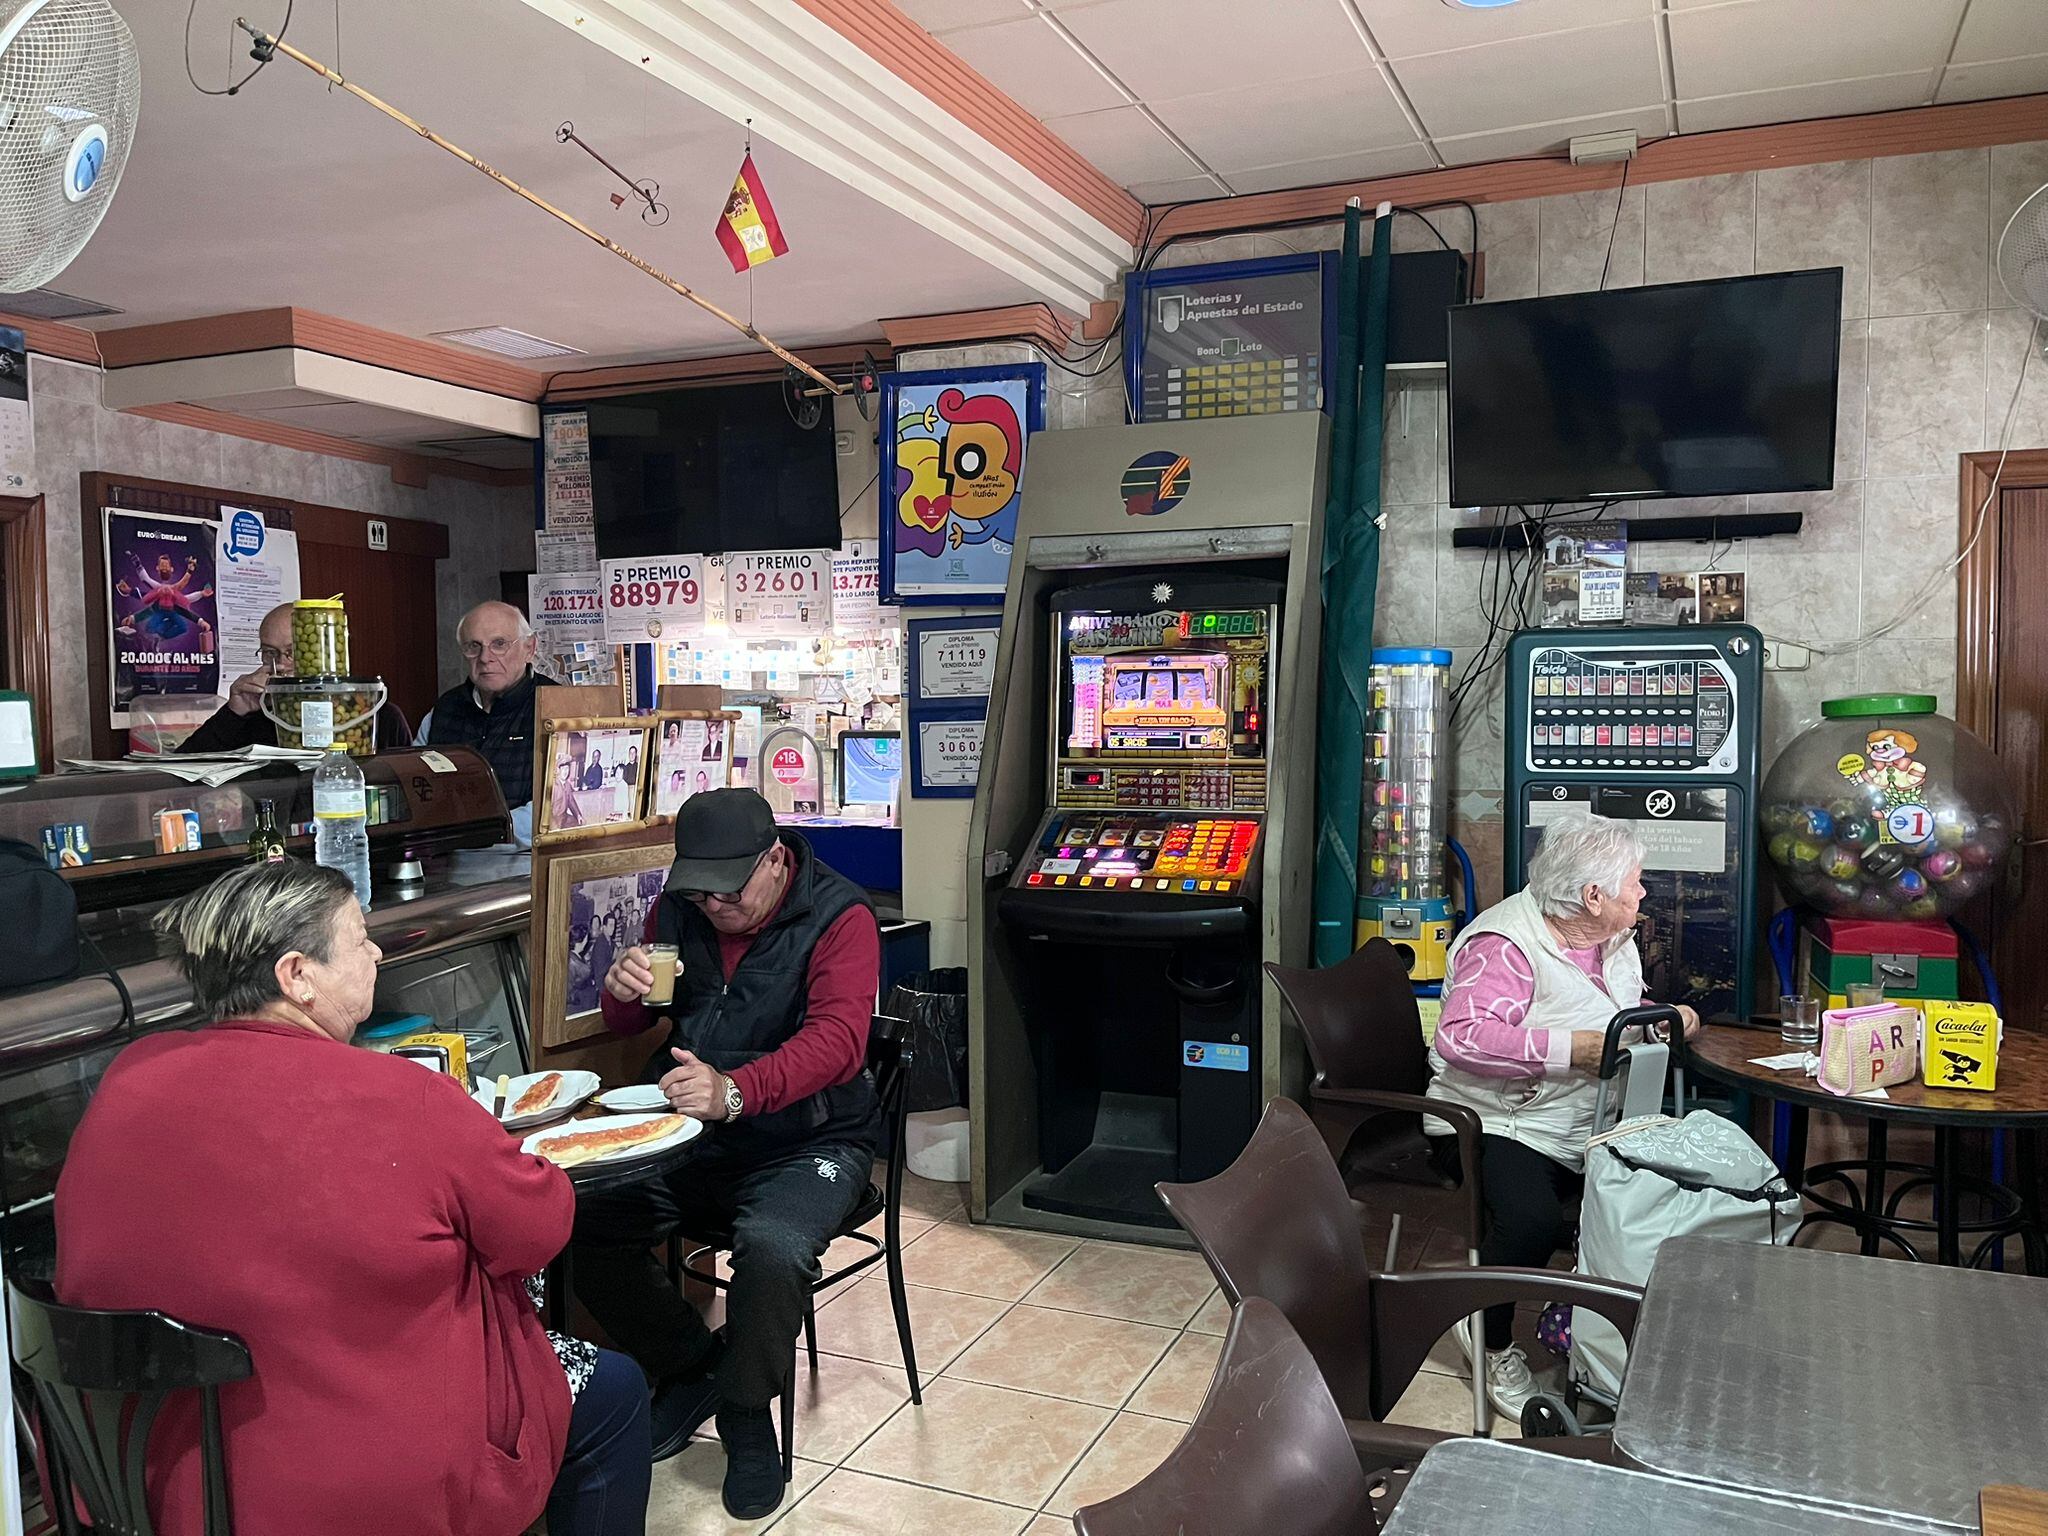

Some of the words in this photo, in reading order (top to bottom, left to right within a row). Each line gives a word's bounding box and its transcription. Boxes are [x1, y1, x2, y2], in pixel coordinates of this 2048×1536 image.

[1186, 293, 1231, 306] Loterías
[1235, 293, 1242, 303] y
[1187, 307, 1239, 322] Apuestas
[1242, 304, 1260, 315] del
[1263, 301, 1303, 314] Estado
[1197, 346, 1220, 356] Bono
[1240, 343, 1262, 352] Loto
[552, 516, 585, 524] VENDIDO
[137, 530, 155, 538] EURO
[161, 533, 188, 542] DREAMS
[757, 555, 812, 570] PREMIO
[627, 564, 691, 582] PREMIO
[735, 571, 819, 593] 32601
[609, 579, 699, 608] 88979
[543, 595, 595, 611] 120.171
[173, 652, 189, 664] AL
[190, 652, 214, 665] MES
[938, 649, 986, 662] 71119
[941, 661, 967, 669] VENDIDO
[1534, 664, 1568, 674] Telde
[1699, 708, 1720, 717] PEDRO
[1122, 738, 1148, 747] SACOS
[778, 751, 797, 764] +18
[1138, 777, 1151, 785] 100
[1151, 787, 1163, 795] 120
[1167, 798, 1180, 806] 100
[1910, 812, 1925, 837] 1
[1658, 835, 1672, 843] del
[1674, 835, 1703, 844] tabaco
[1057, 847, 1071, 858] 1
[1083, 847, 1099, 858] 2
[1935, 1017, 1988, 1036] Cacaolat
[1869, 1029, 1885, 1054] A
[1890, 1025, 1904, 1050] R
[1871, 1058, 1885, 1082] P
